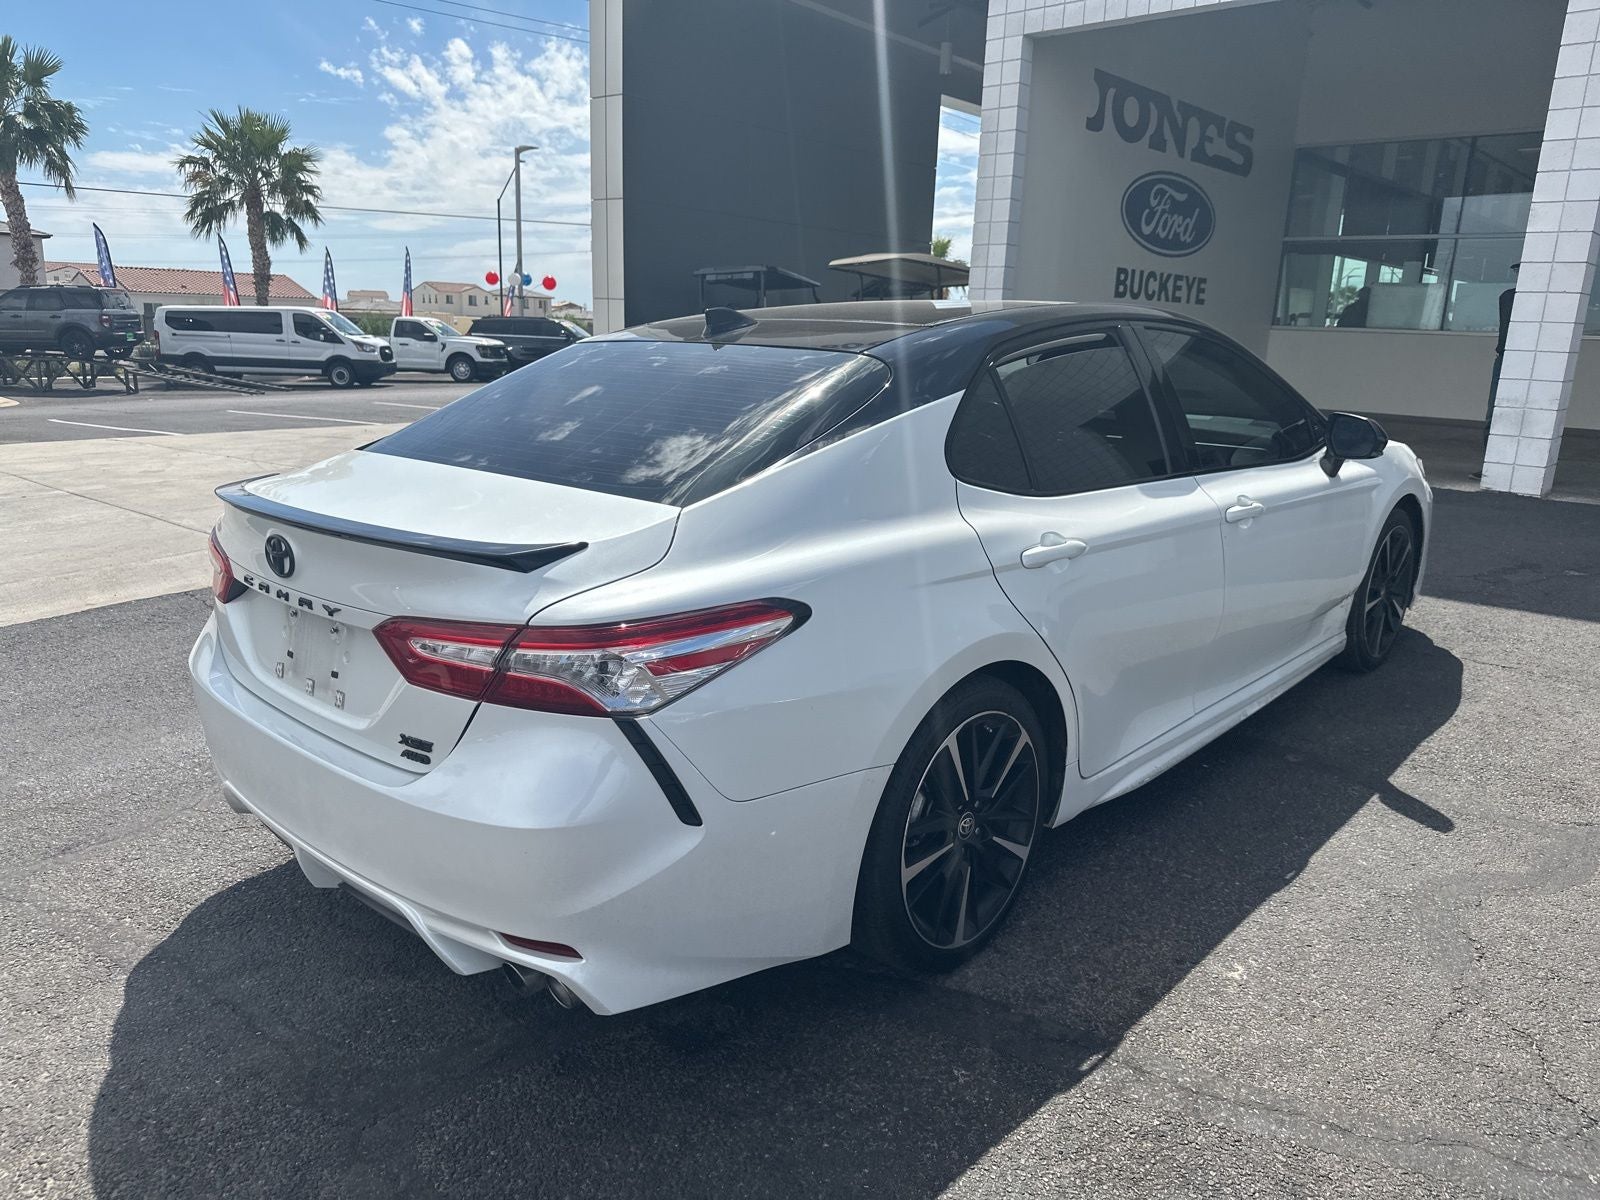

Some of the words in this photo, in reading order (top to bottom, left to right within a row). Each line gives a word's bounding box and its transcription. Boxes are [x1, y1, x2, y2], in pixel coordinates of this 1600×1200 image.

[1085, 67, 1255, 178] JONES
[1140, 183, 1200, 243] Ford
[1113, 267, 1208, 306] BUCKEYE
[243, 574, 342, 617] CAMRY
